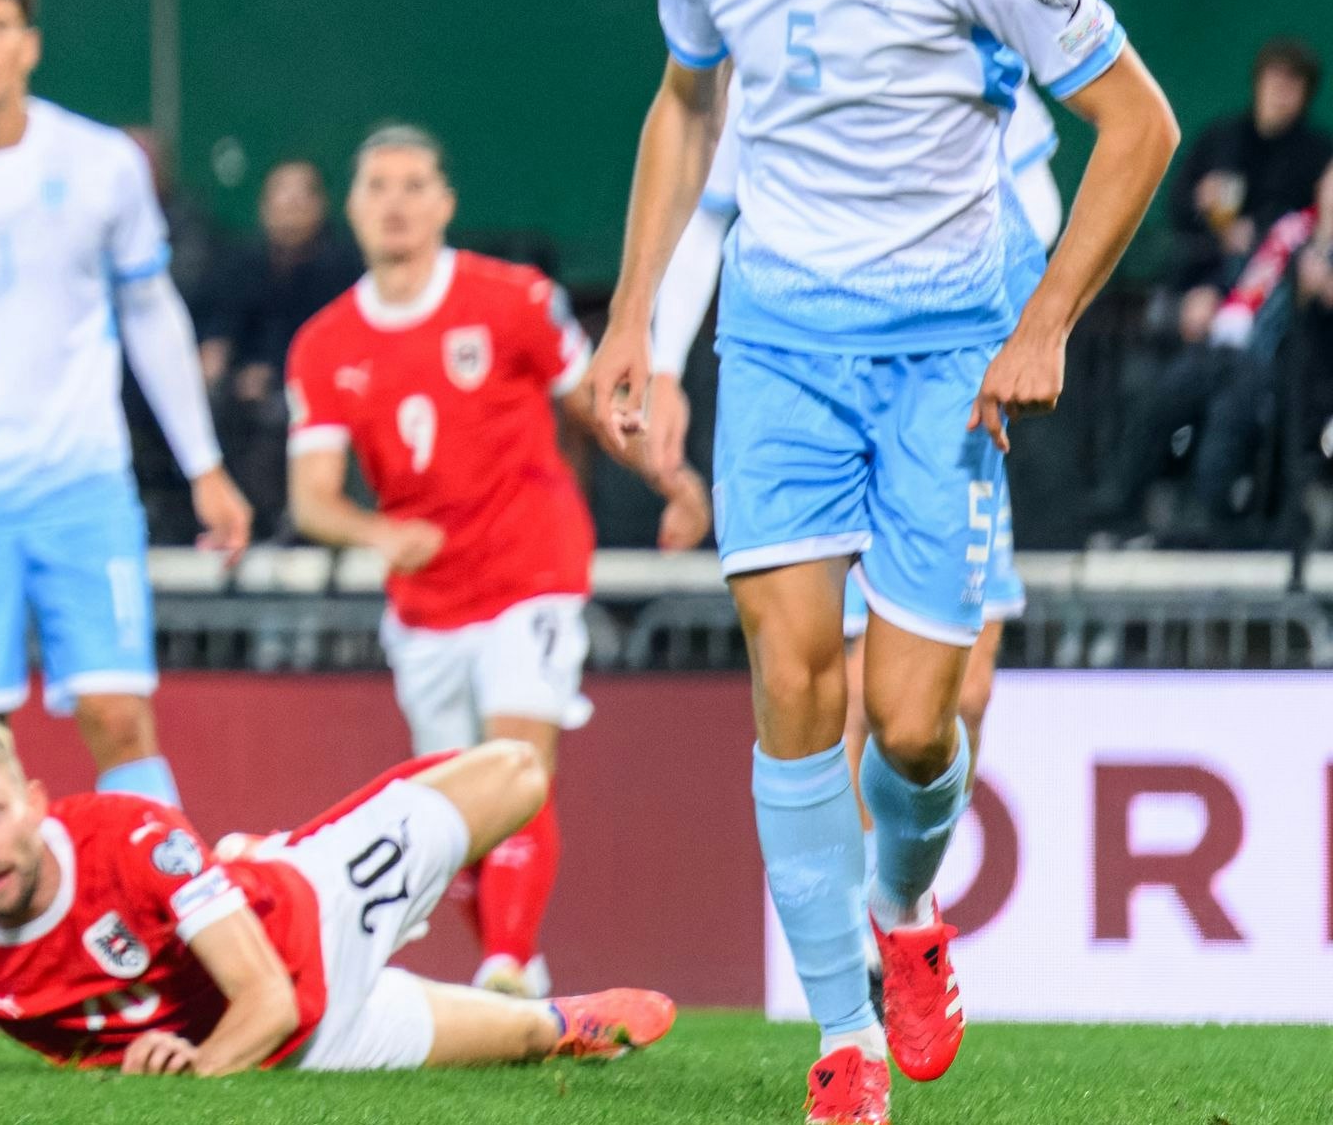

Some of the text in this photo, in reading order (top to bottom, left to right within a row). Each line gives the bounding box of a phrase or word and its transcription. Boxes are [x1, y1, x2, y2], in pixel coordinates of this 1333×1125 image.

[784, 12, 822, 90] 5
[397, 393, 438, 474] 9
[966, 480, 994, 563] 5
[346, 836, 409, 935] 20
